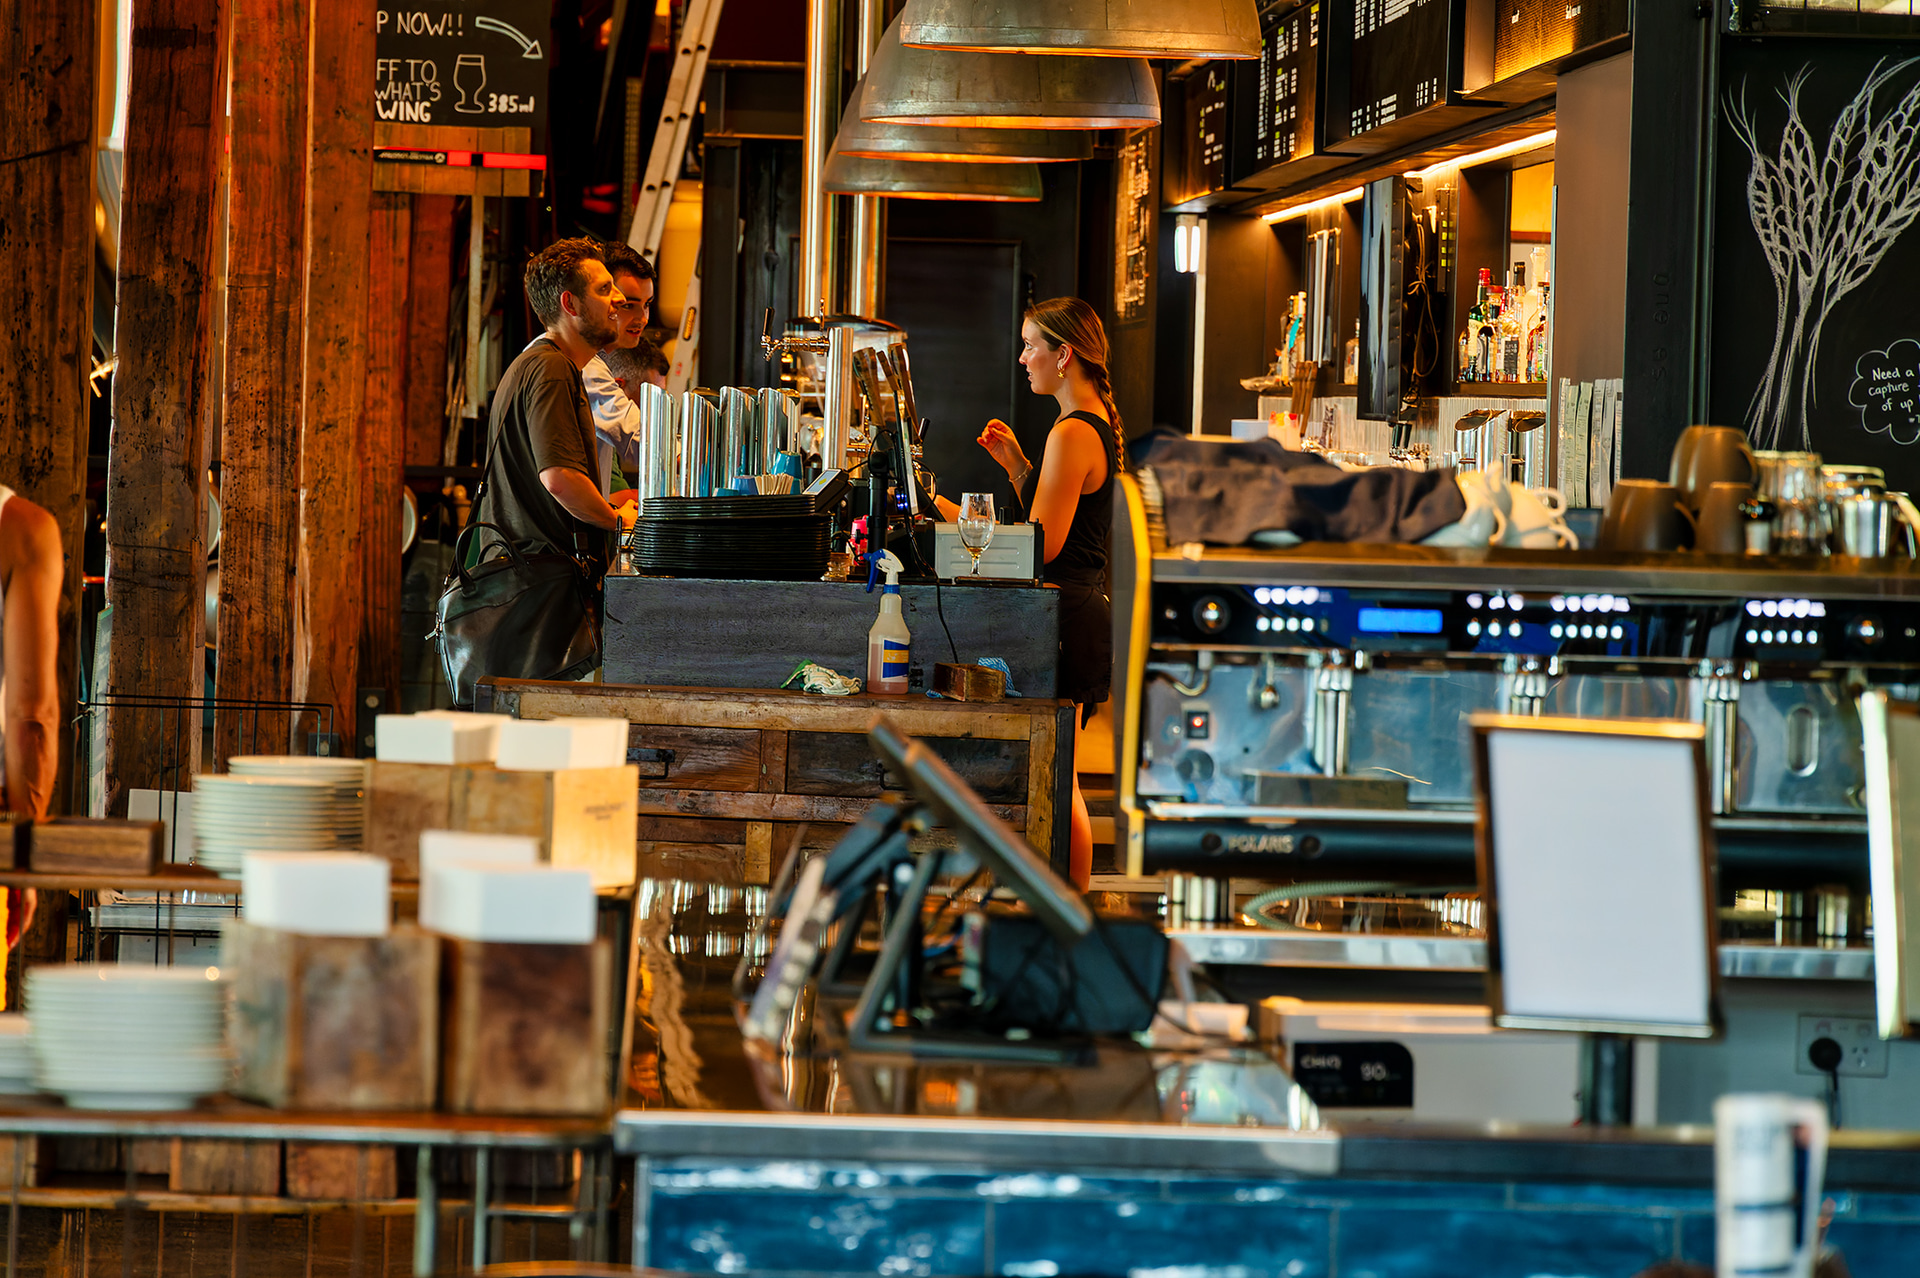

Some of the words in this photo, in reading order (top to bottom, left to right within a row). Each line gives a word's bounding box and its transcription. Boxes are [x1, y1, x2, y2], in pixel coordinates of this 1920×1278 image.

[397, 11, 463, 36] NOW!!
[405, 59, 437, 84] TO
[374, 81, 441, 102] WHAT'S
[376, 100, 431, 123] WING
[488, 93, 535, 113] 385ml
[1872, 367, 1900, 381] Need
[1905, 369, 1915, 377] a
[1868, 382, 1909, 398] capture
[1881, 398, 1893, 411] of
[1900, 399, 1914, 413] up
